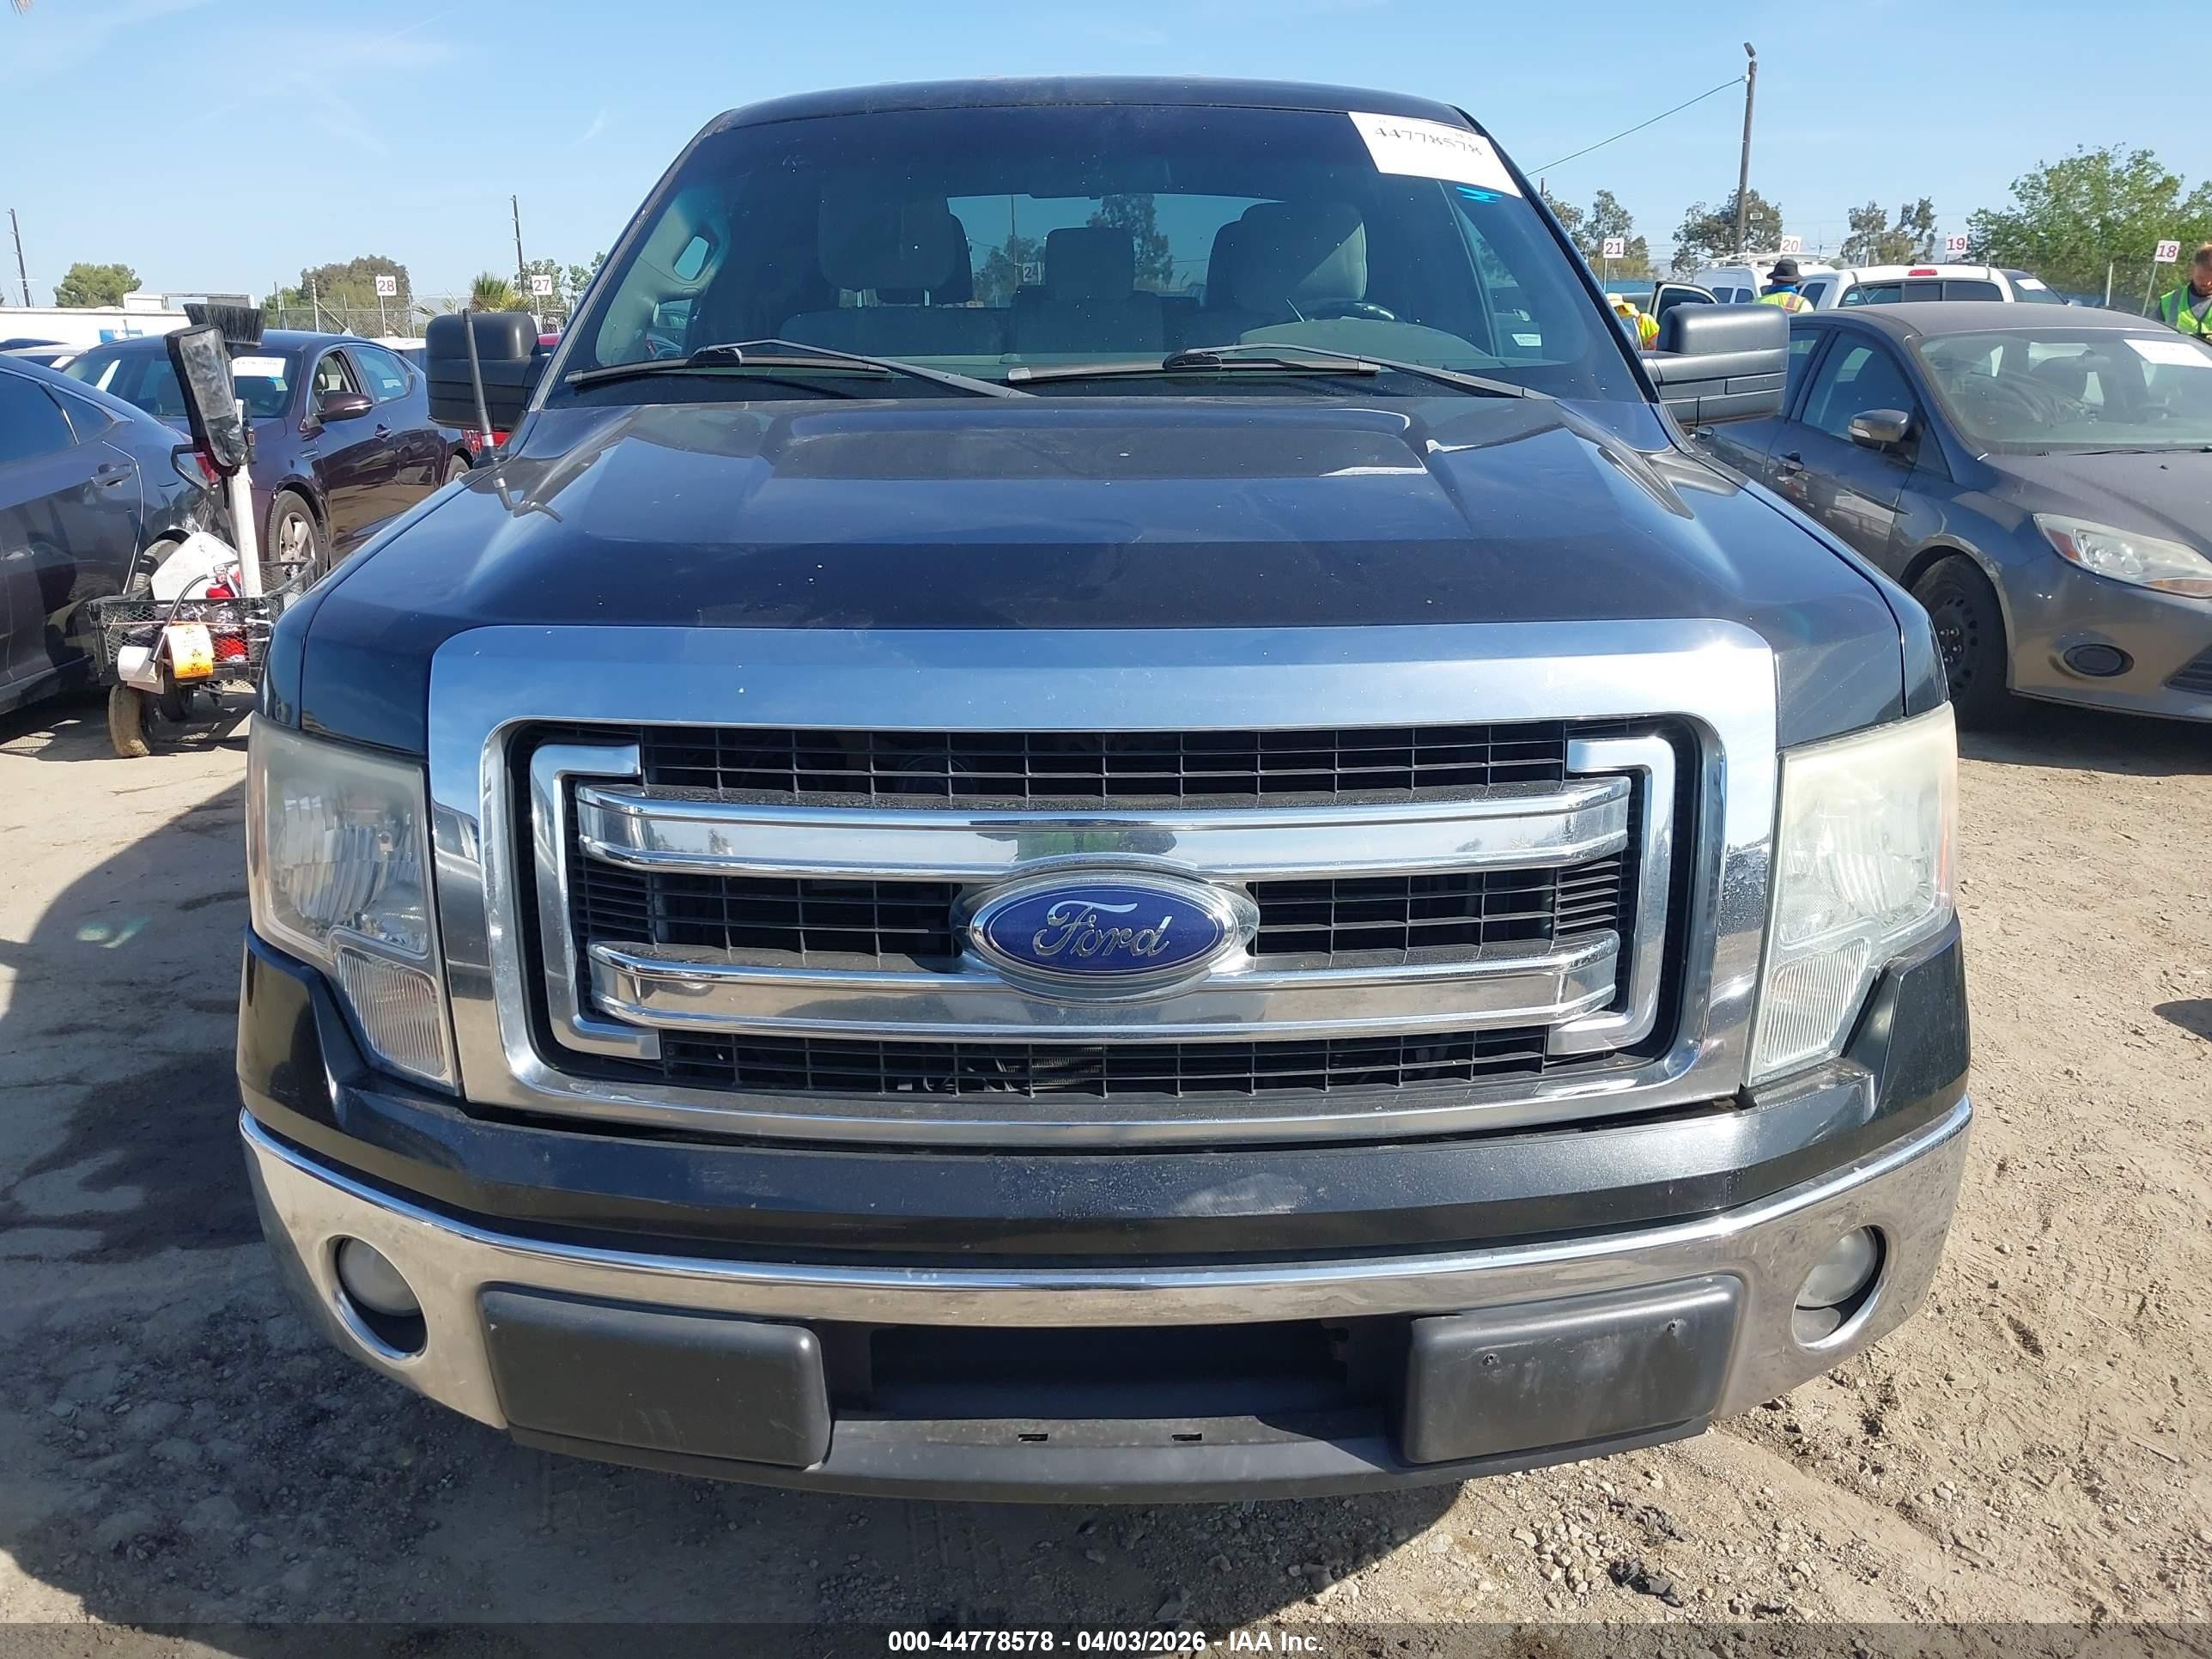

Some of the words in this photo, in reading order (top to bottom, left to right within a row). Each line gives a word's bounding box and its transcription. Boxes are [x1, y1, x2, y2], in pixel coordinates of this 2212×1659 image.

[1375, 127, 1482, 155] 44778578
[1605, 241, 1622, 254] 21
[1783, 240, 1799, 252] 20
[1947, 237, 1966, 251] 19
[2156, 245, 2177, 258] 18
[378, 280, 395, 292] 28
[533, 279, 550, 292] 27
[1033, 900, 1172, 957] Ford
